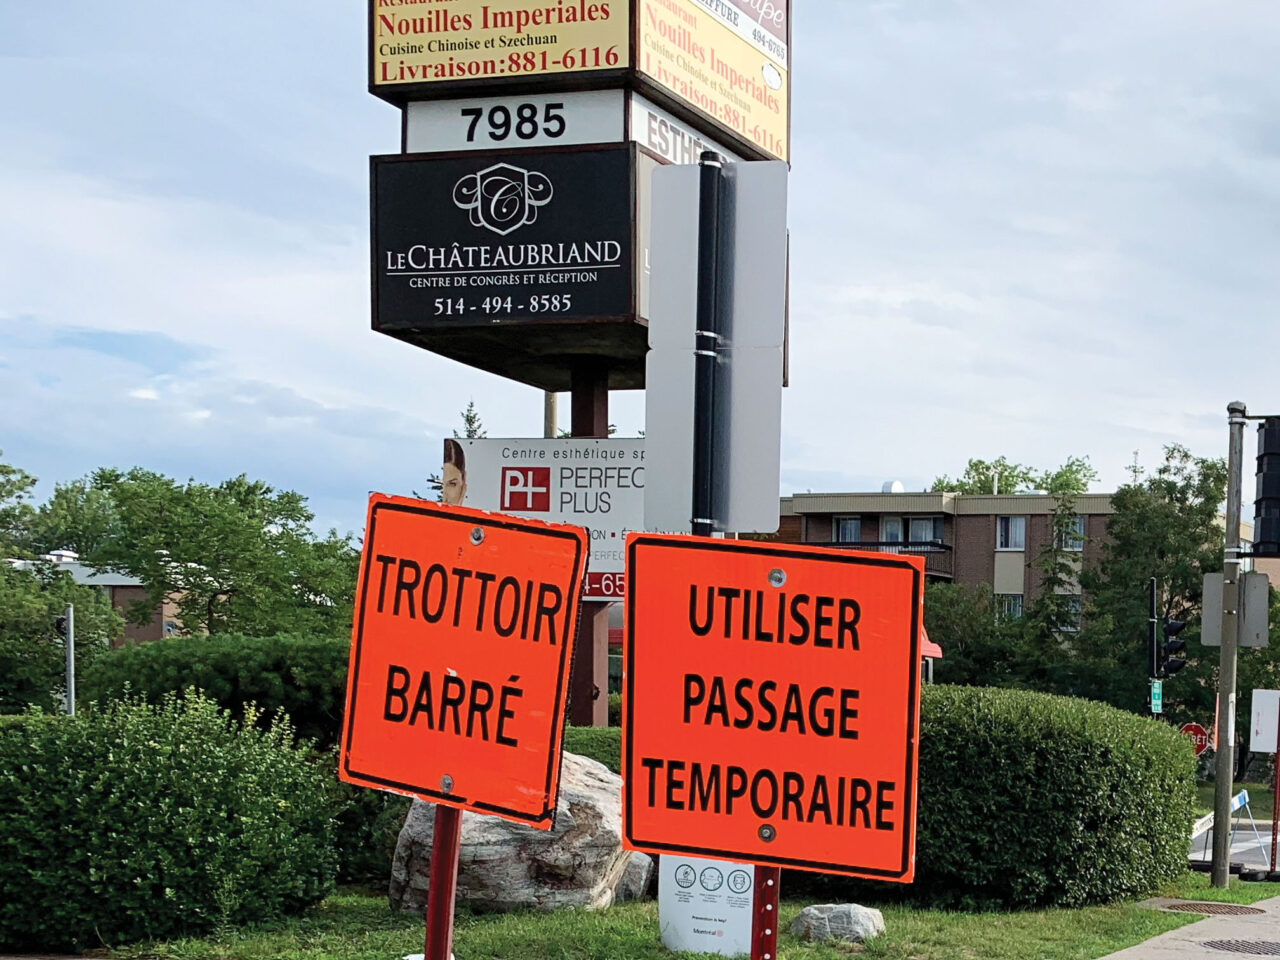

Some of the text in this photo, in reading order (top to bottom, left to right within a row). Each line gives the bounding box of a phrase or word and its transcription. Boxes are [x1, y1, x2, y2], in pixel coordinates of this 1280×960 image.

[378, 0, 610, 37] Nouilles Imperiales
[379, 33, 558, 56] Cuisine Chinoise et Szechuan
[380, 45, 620, 82] Livraison:881-6116
[645, 3, 780, 114] Nouilles Imperiales
[460, 103, 567, 142] 7985
[646, 52, 783, 157] Livraison:881-6116
[409, 271, 598, 288] CENTRE DE CONGRÈS ET RÉCEPTION
[502, 447, 546, 459] Centre
[553, 446, 625, 461] esthétique
[560, 491, 611, 513] PLUS
[376, 554, 564, 645] TROTTOIR
[688, 584, 862, 651] UTILISER
[383, 664, 523, 748] BARRÉ
[683, 674, 861, 740] PASSAGE
[641, 757, 896, 832] TEMPORAIRE
